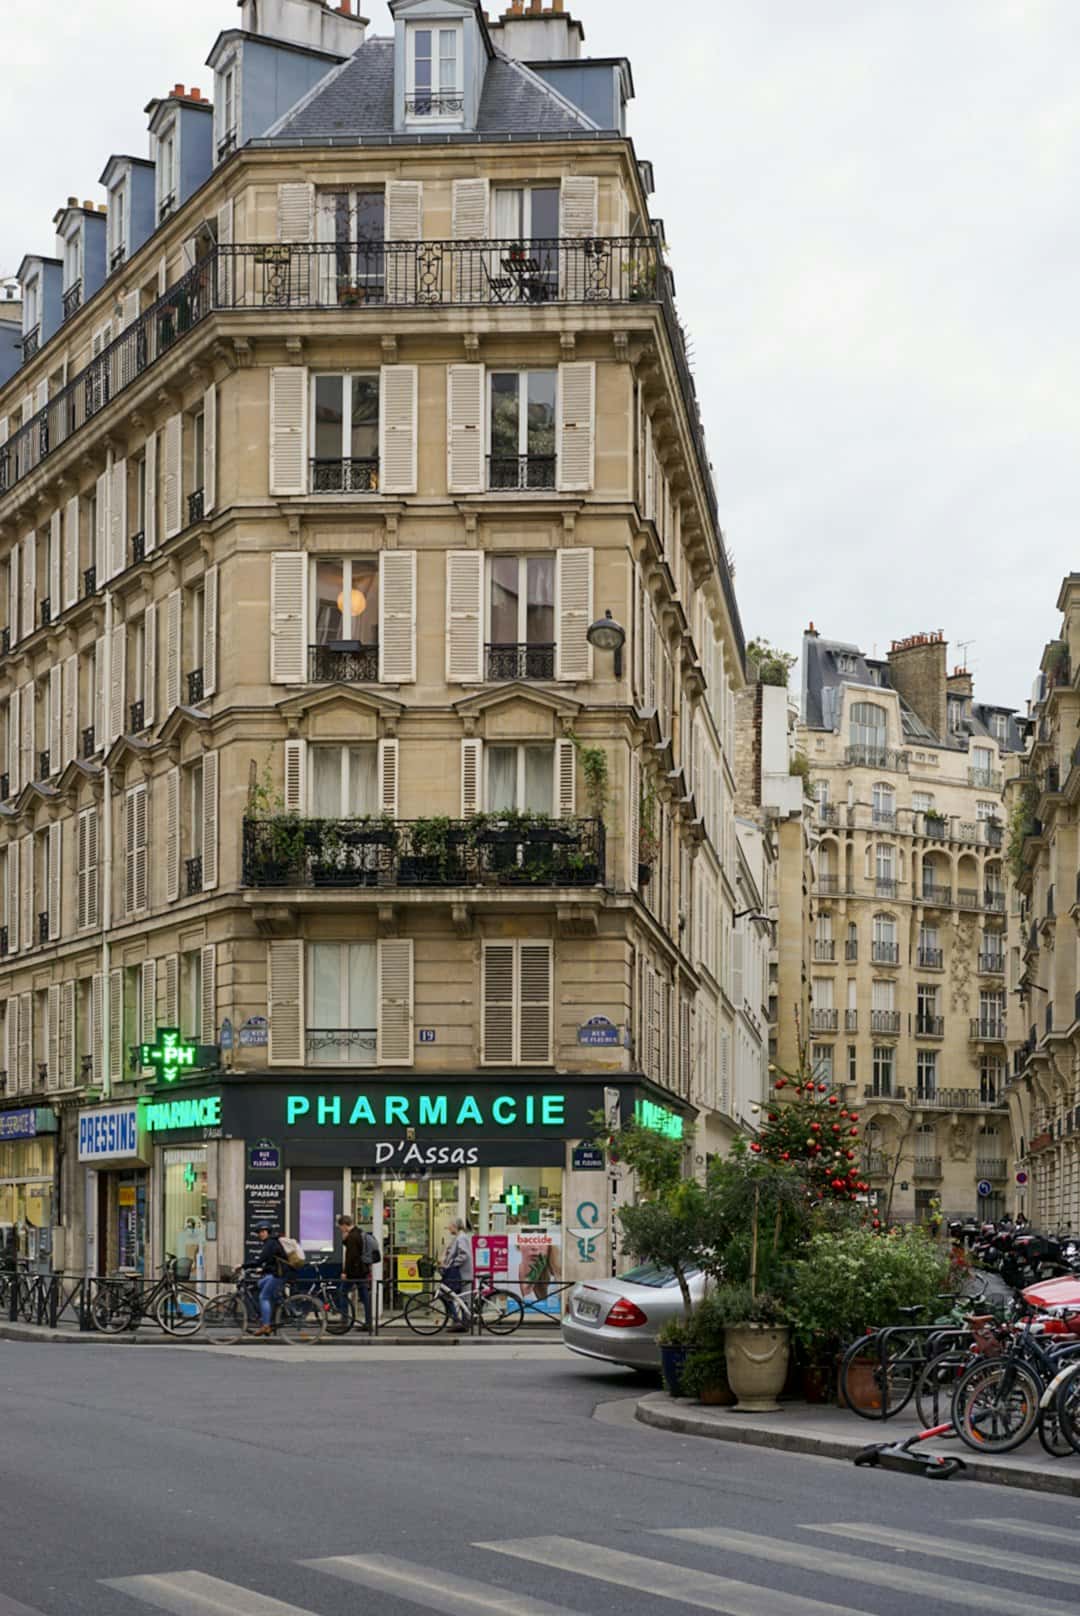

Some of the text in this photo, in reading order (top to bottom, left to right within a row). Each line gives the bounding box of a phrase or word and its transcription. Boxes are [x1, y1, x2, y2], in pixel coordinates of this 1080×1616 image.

[421, 1031, 434, 1041] 19
[146, 1096, 221, 1131] PHARMACIE
[287, 1095, 565, 1125] PHARMACIE
[80, 1111, 136, 1154] PRESSING
[375, 1141, 478, 1164] D'Assas
[516, 1234, 552, 1244] baccide
